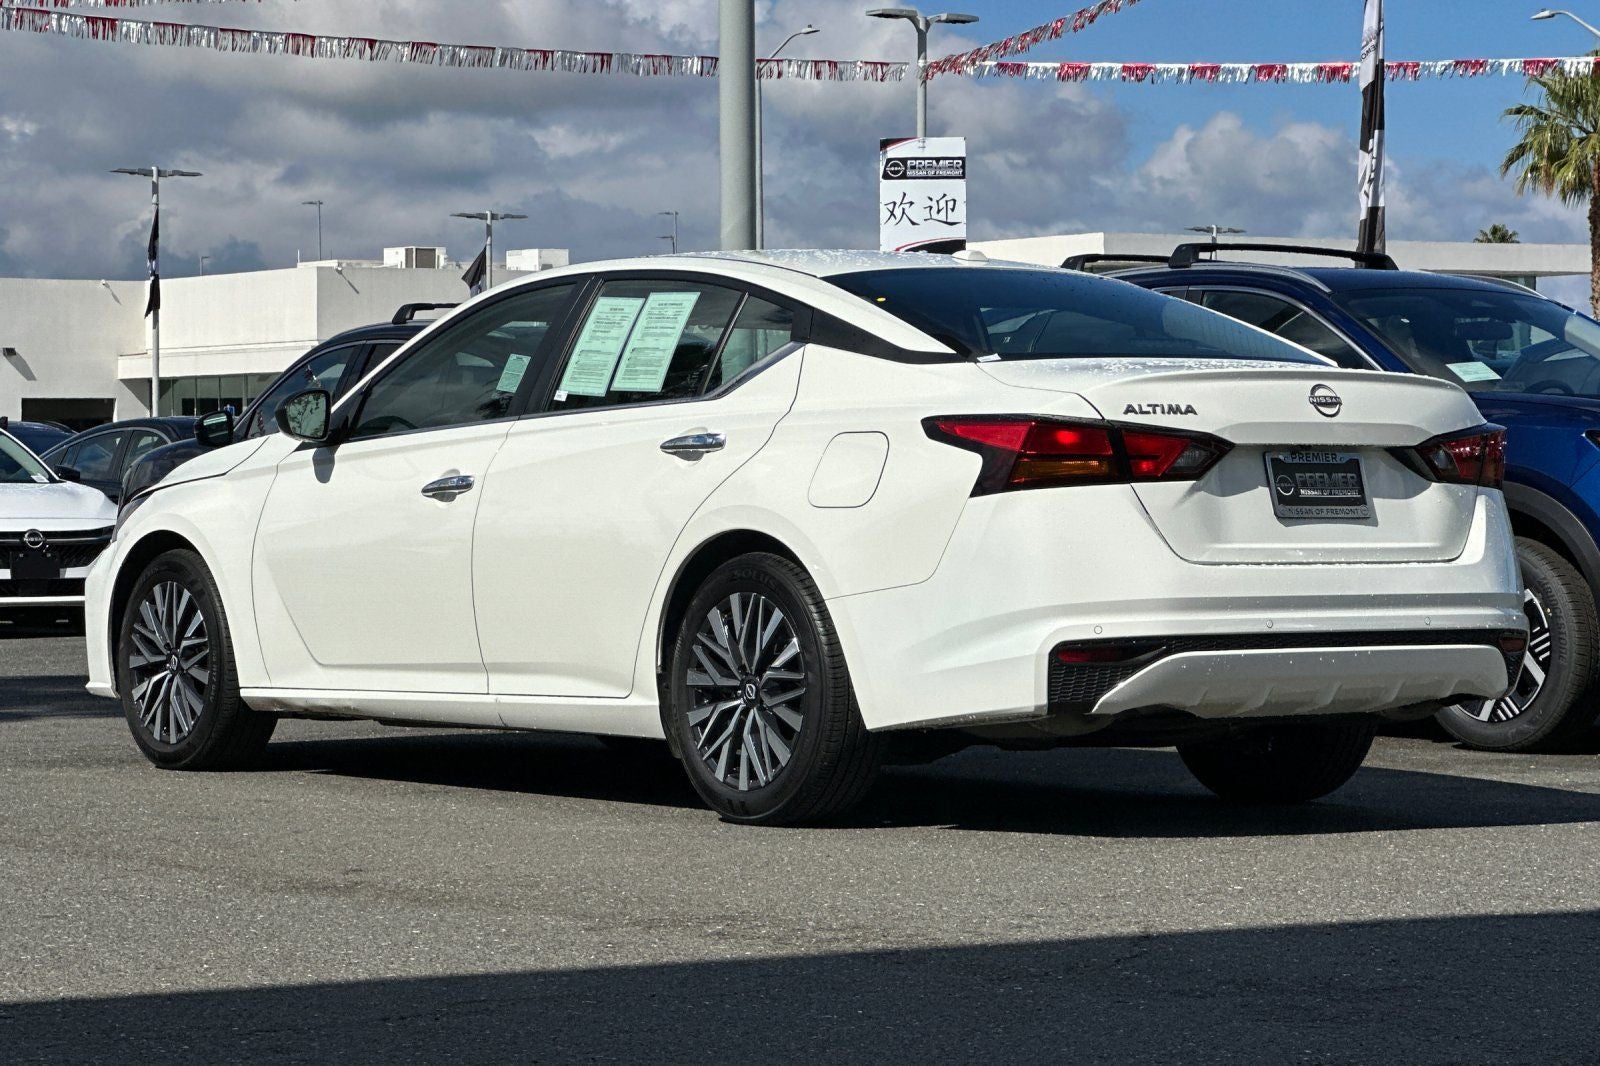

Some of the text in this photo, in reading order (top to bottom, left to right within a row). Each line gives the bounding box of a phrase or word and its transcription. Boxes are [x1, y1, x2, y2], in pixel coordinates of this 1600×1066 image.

[907, 160, 963, 170] PREMIER
[884, 192, 962, 226] 欢迎
[1309, 396, 1341, 404] NISSAN
[1123, 403, 1198, 416] ALTIMA
[1291, 453, 1338, 462] PREMIER
[1295, 473, 1358, 487] PREMIER
